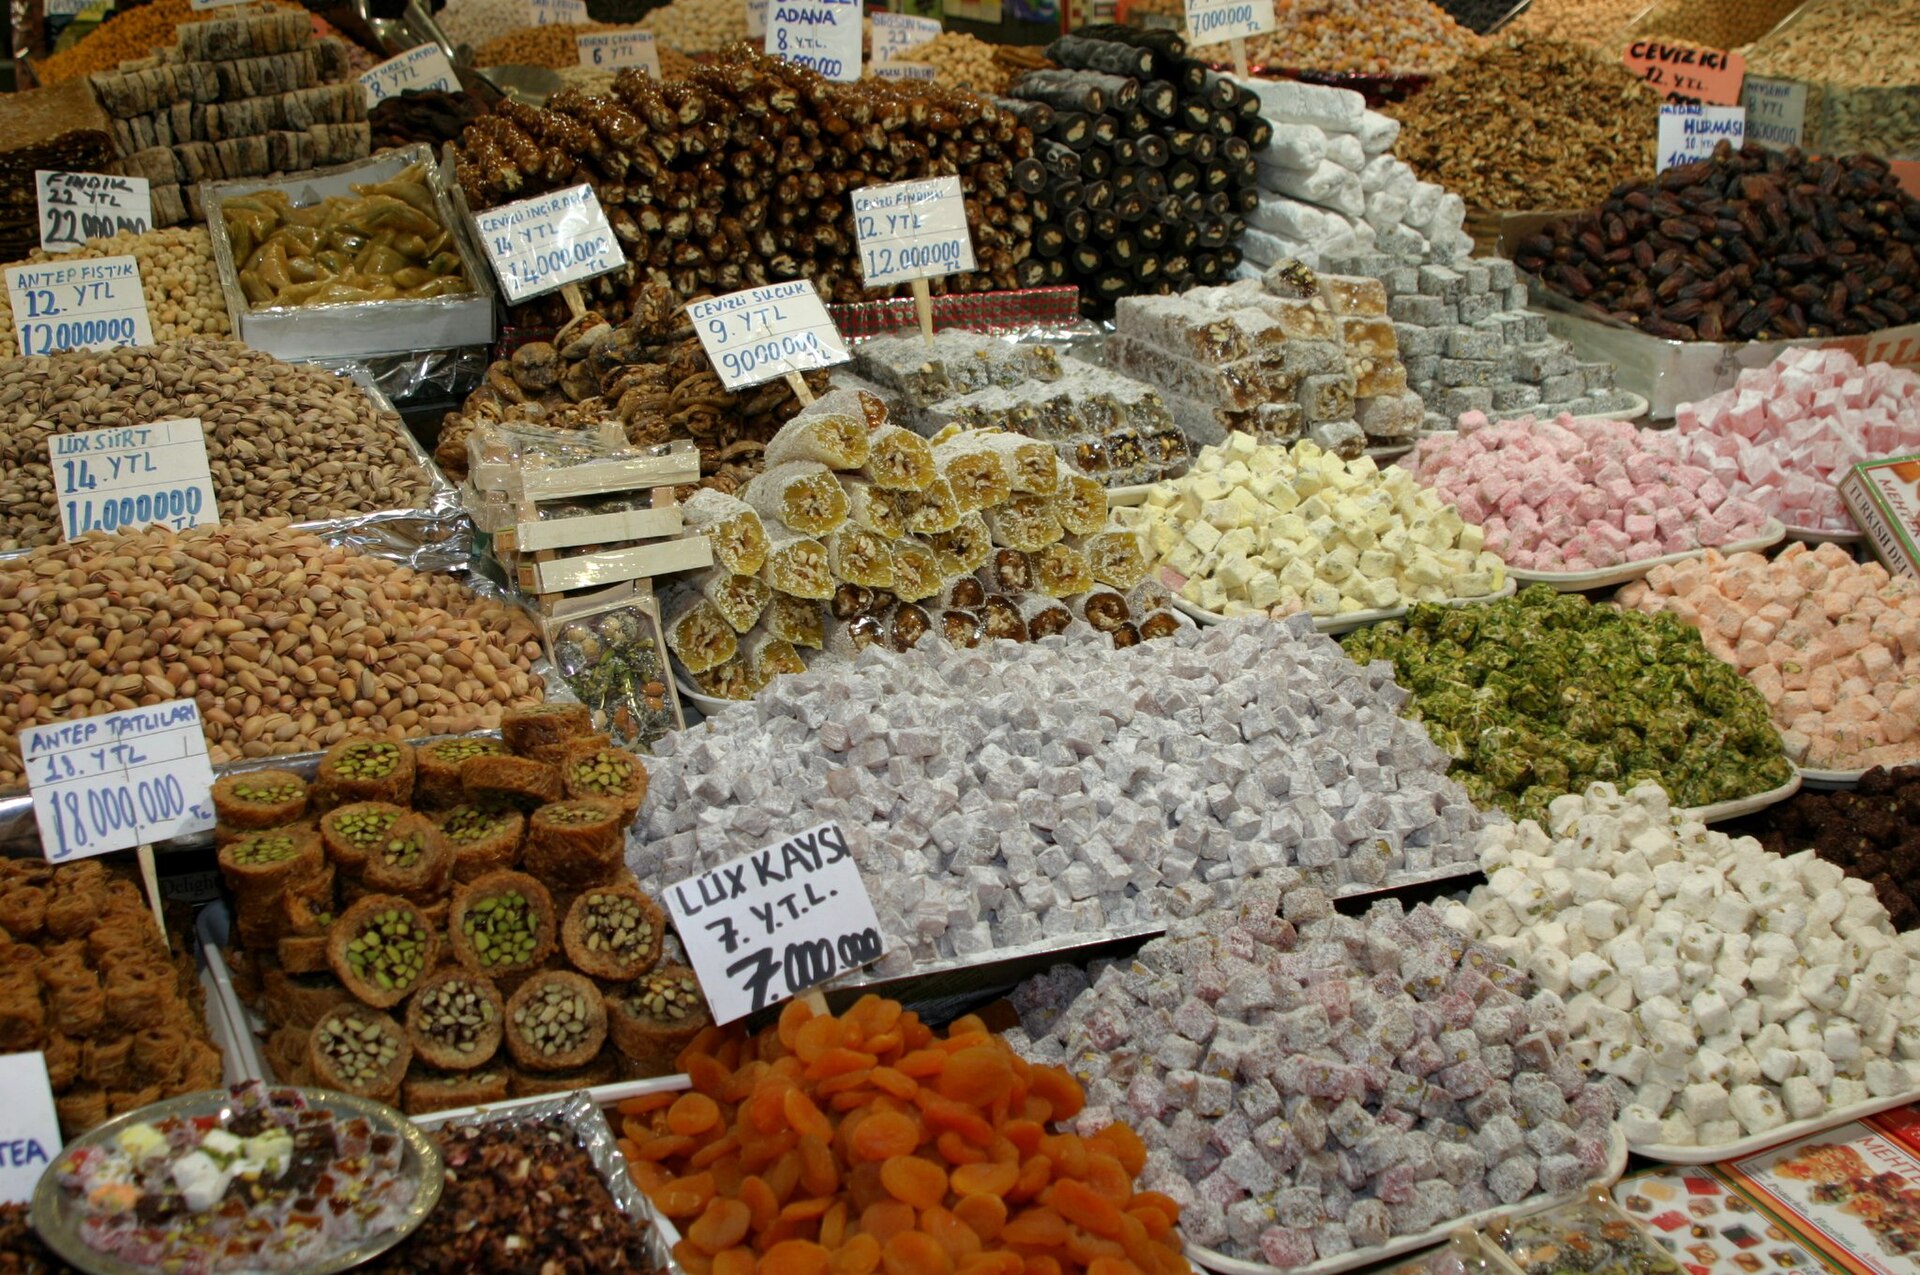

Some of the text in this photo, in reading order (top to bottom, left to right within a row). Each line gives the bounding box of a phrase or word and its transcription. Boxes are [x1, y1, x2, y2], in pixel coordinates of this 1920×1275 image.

[775, 8, 836, 25] ADANA
[593, 48, 602, 64] 6
[46, 172, 134, 193] FINDIK
[47, 188, 121, 208] 22 YTL
[518, 222, 560, 243] YTL
[886, 214, 922, 235] YTL
[586, 258, 609, 272] TL
[943, 260, 961, 272] TL
[18, 264, 134, 290] ANTEP FISTIK
[73, 281, 116, 307] YTL
[752, 282, 806, 303] SUCUK
[737, 304, 788, 332] YTL
[57, 434, 90, 455] LÜX
[107, 451, 158, 480] YTL
[171, 516, 198, 530] TL
[1849, 483, 1891, 548] TURKISH
[31, 704, 197, 753] ANTEP TATLILARI
[90, 744, 147, 771] YTL
[675, 825, 852, 917] LÜX KAYSI
[0, 1138, 49, 1168] TEA
